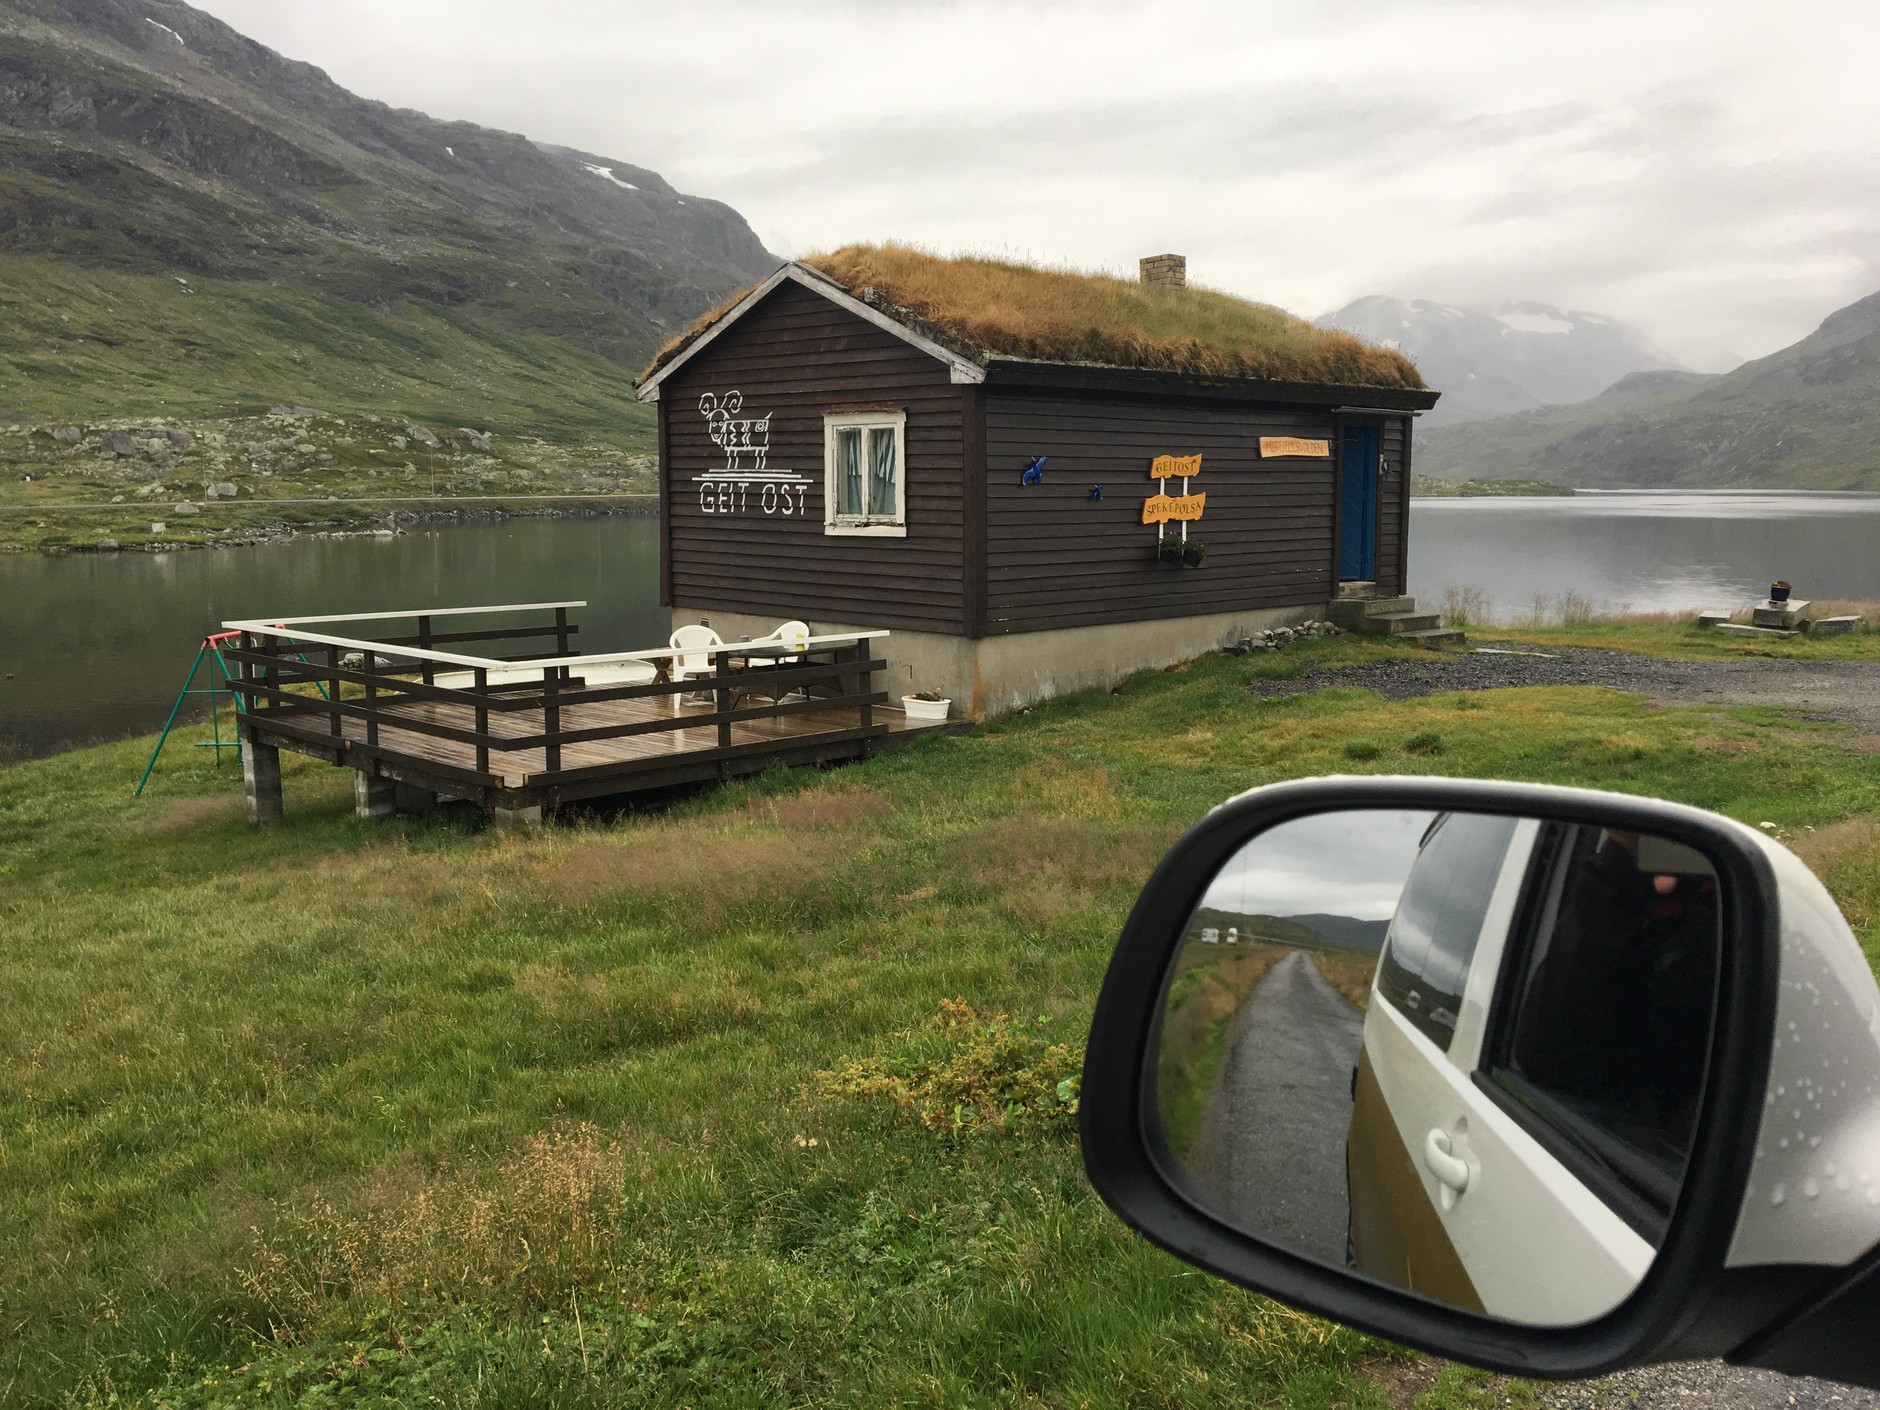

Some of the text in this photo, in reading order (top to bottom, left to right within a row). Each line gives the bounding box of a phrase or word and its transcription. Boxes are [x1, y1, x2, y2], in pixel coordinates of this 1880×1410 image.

[1156, 460, 1194, 473] GEITOST
[699, 482, 808, 515] GEIT OST
[1146, 501, 1201, 517] SPEKEPØLSA
